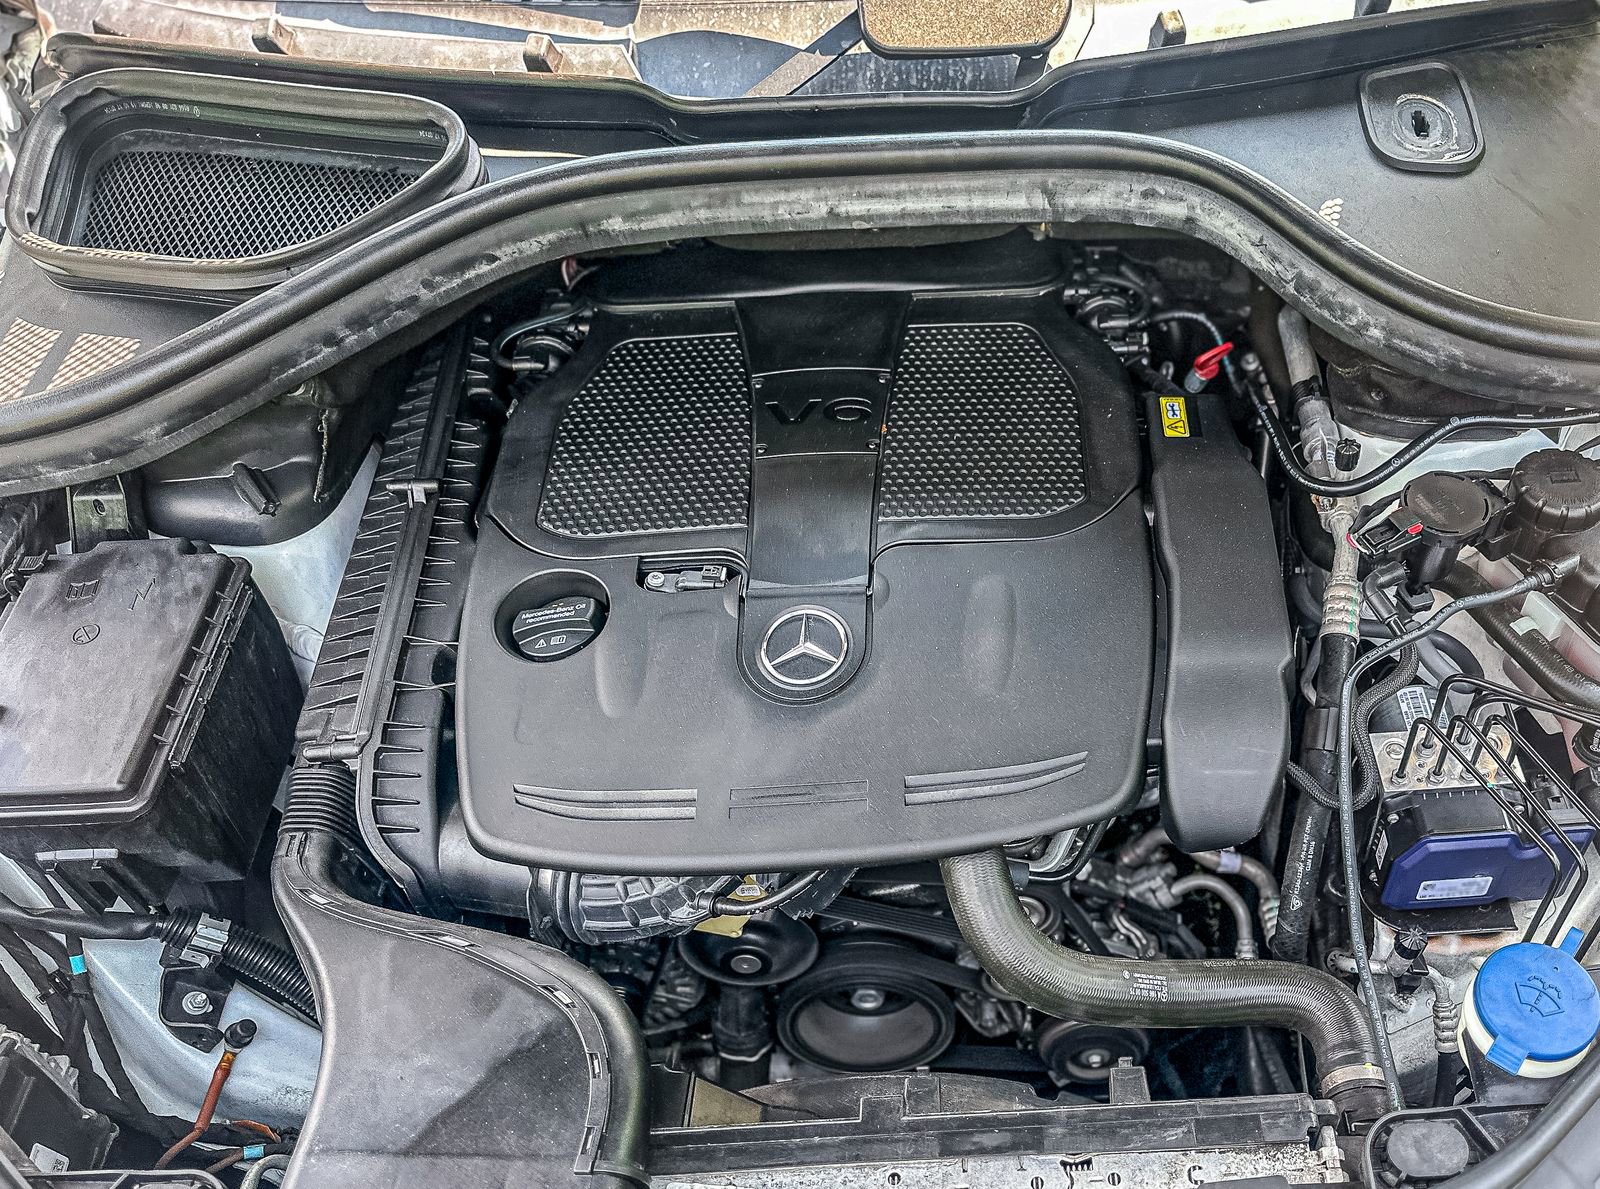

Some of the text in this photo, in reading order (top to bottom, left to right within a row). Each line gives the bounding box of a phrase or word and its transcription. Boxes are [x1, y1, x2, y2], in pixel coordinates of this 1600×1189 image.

[765, 396, 873, 425] V6
[521, 605, 574, 620] Mercedes-Benz
[525, 610, 575, 624] recommended
